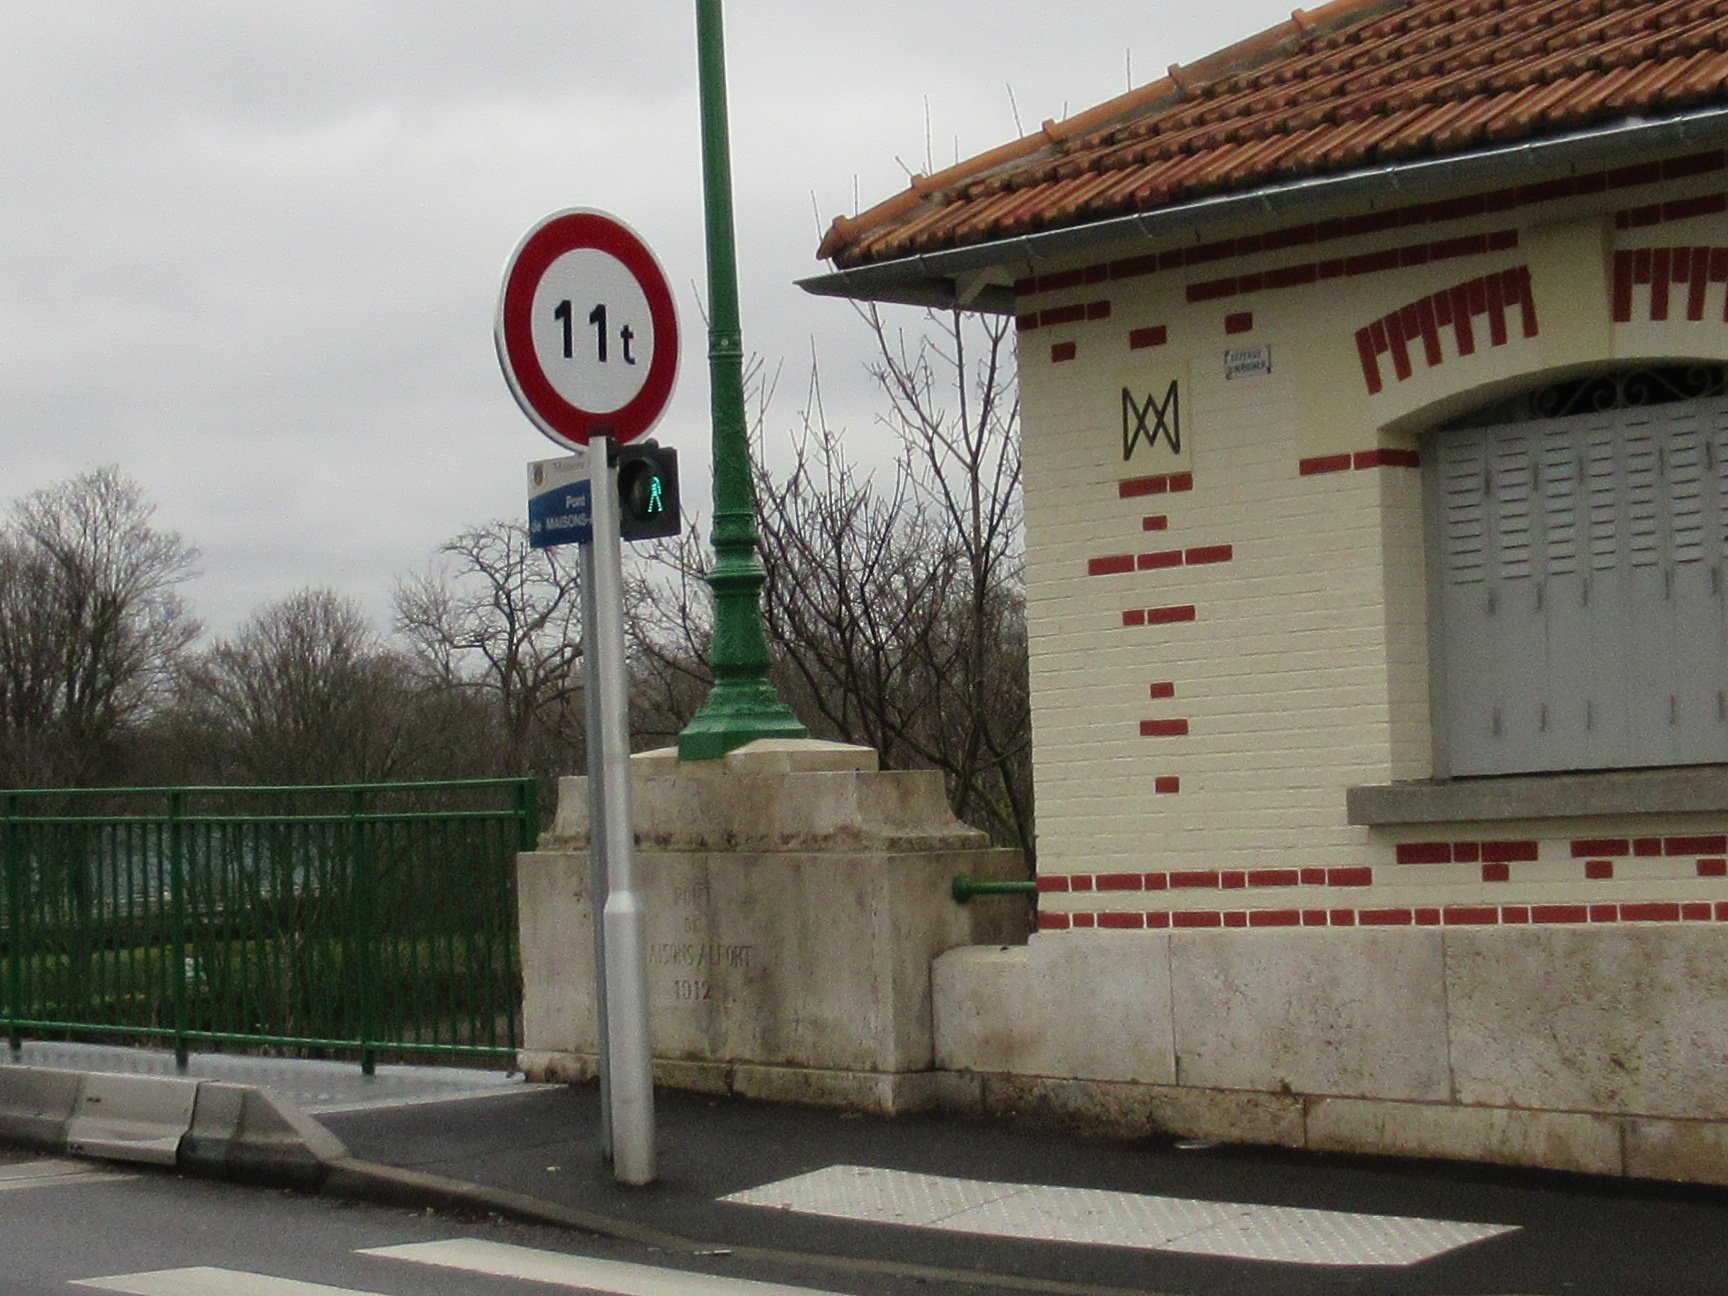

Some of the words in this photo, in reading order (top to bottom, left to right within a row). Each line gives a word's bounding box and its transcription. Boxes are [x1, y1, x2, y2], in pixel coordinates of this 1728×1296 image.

[565, 495, 586, 509] Pont
[531, 520, 542, 533] de
[684, 916, 702, 934] DE
[646, 943, 694, 966] AISONS
[674, 980, 713, 1001] 1912
